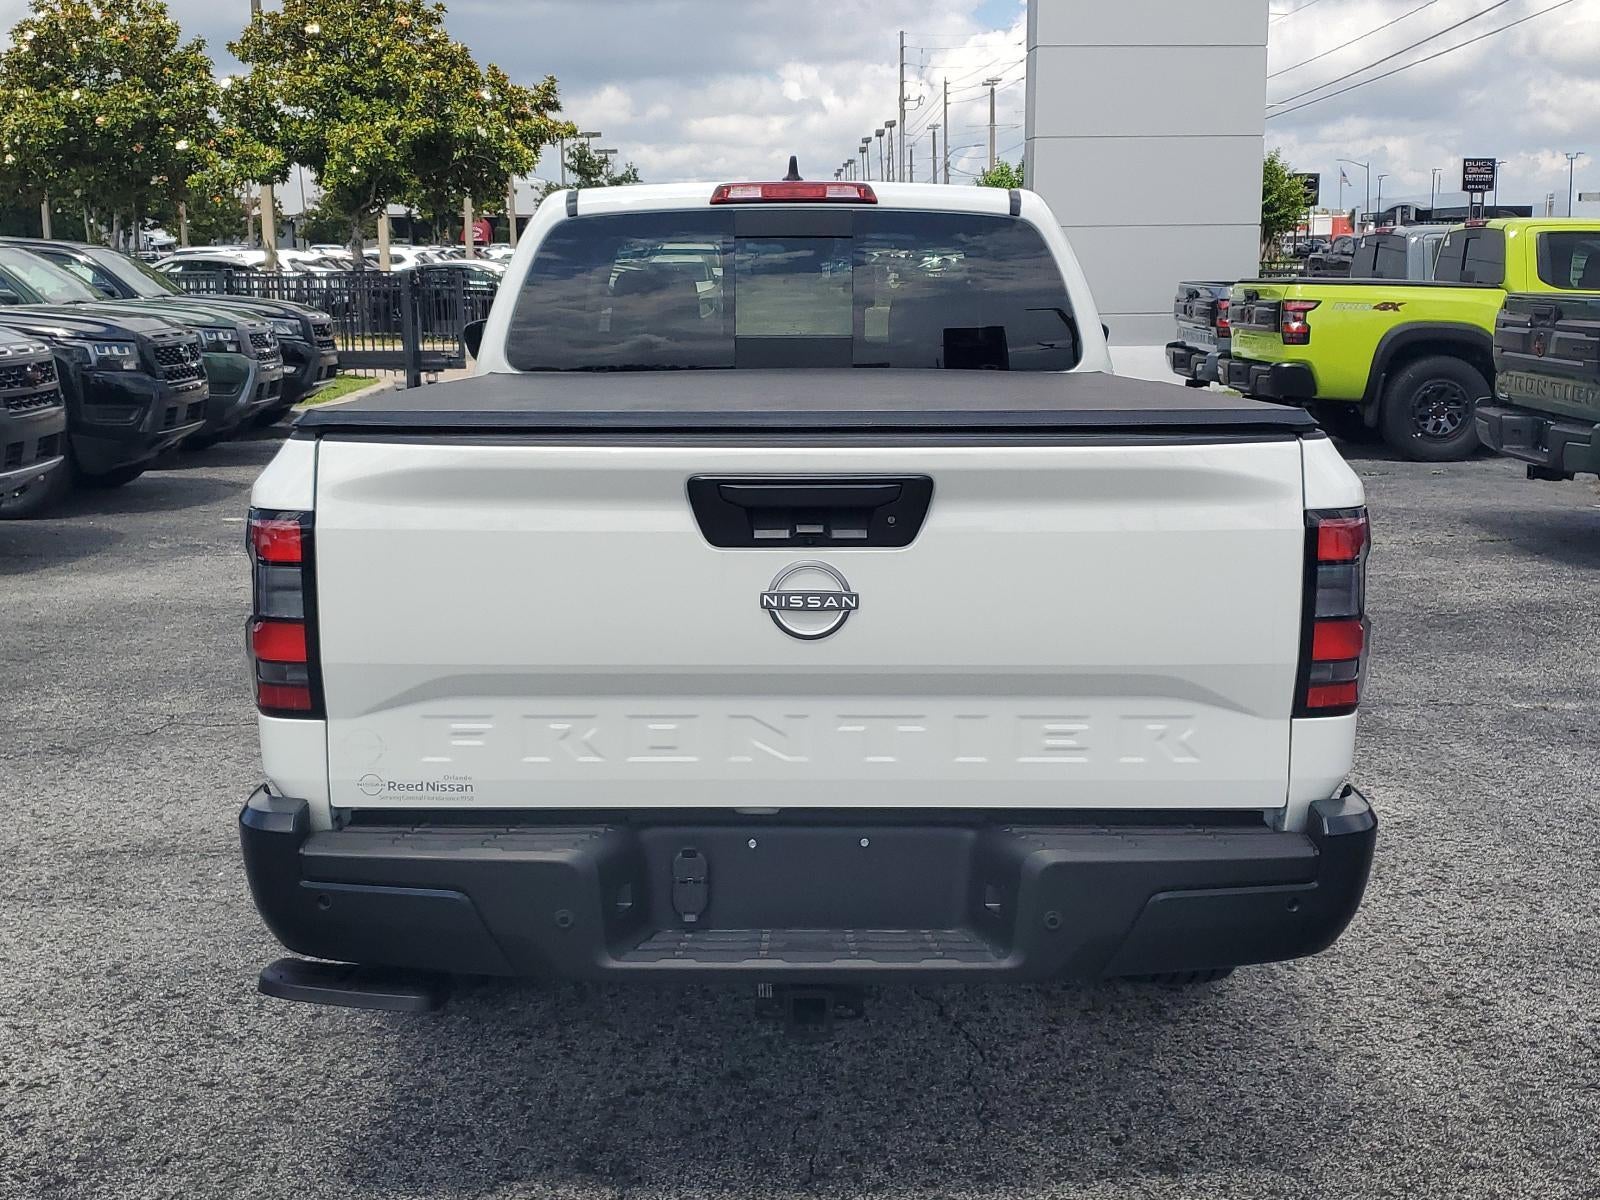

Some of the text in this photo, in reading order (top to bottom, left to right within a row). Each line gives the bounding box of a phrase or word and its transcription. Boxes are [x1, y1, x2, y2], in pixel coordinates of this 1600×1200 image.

[763, 594, 857, 608] NISSAN
[420, 714, 1201, 763] FRONTIER
[387, 781, 474, 792] Reed Nissan
